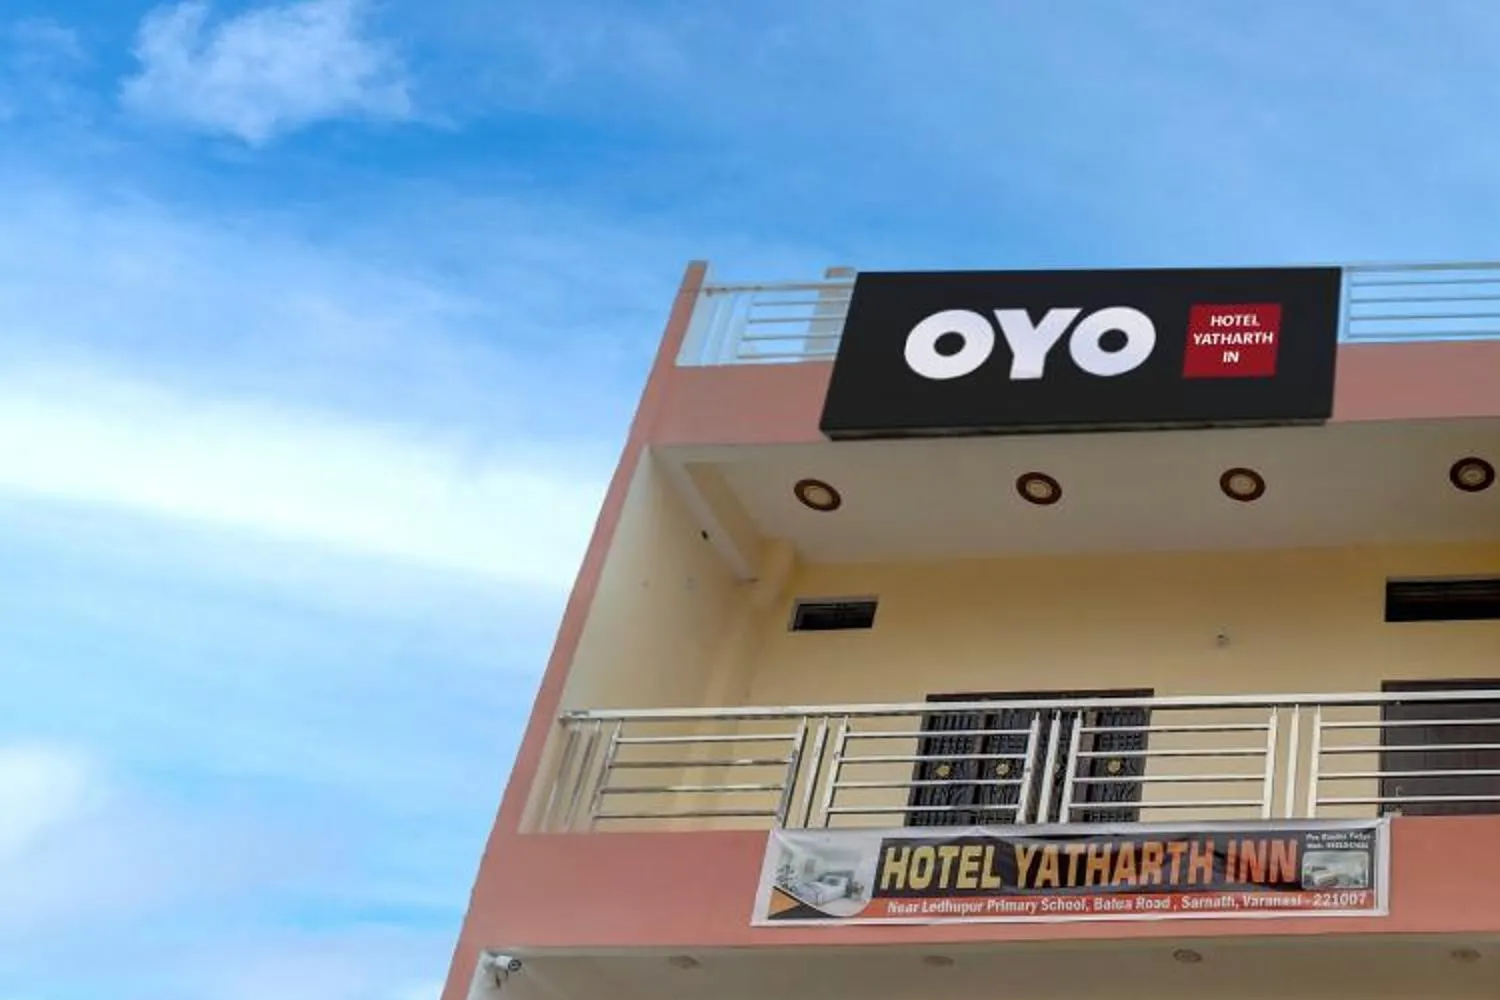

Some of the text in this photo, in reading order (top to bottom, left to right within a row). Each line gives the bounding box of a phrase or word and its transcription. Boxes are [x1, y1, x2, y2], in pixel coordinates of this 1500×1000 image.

[1210, 314, 1260, 327] HOTEL
[904, 305, 1156, 380] OYO
[1193, 331, 1273, 345] YATHARTH
[1223, 351, 1239, 363] IN
[880, 839, 1297, 890] HOTEL YATHARTH INN
[887, 901, 918, 913] Near
[987, 899, 1037, 914] Primary
[1041, 896, 1090, 912] School,
[1135, 896, 1170, 910] Road
[1181, 895, 1239, 910] Sarnath,
[1312, 892, 1367, 907] 221007
